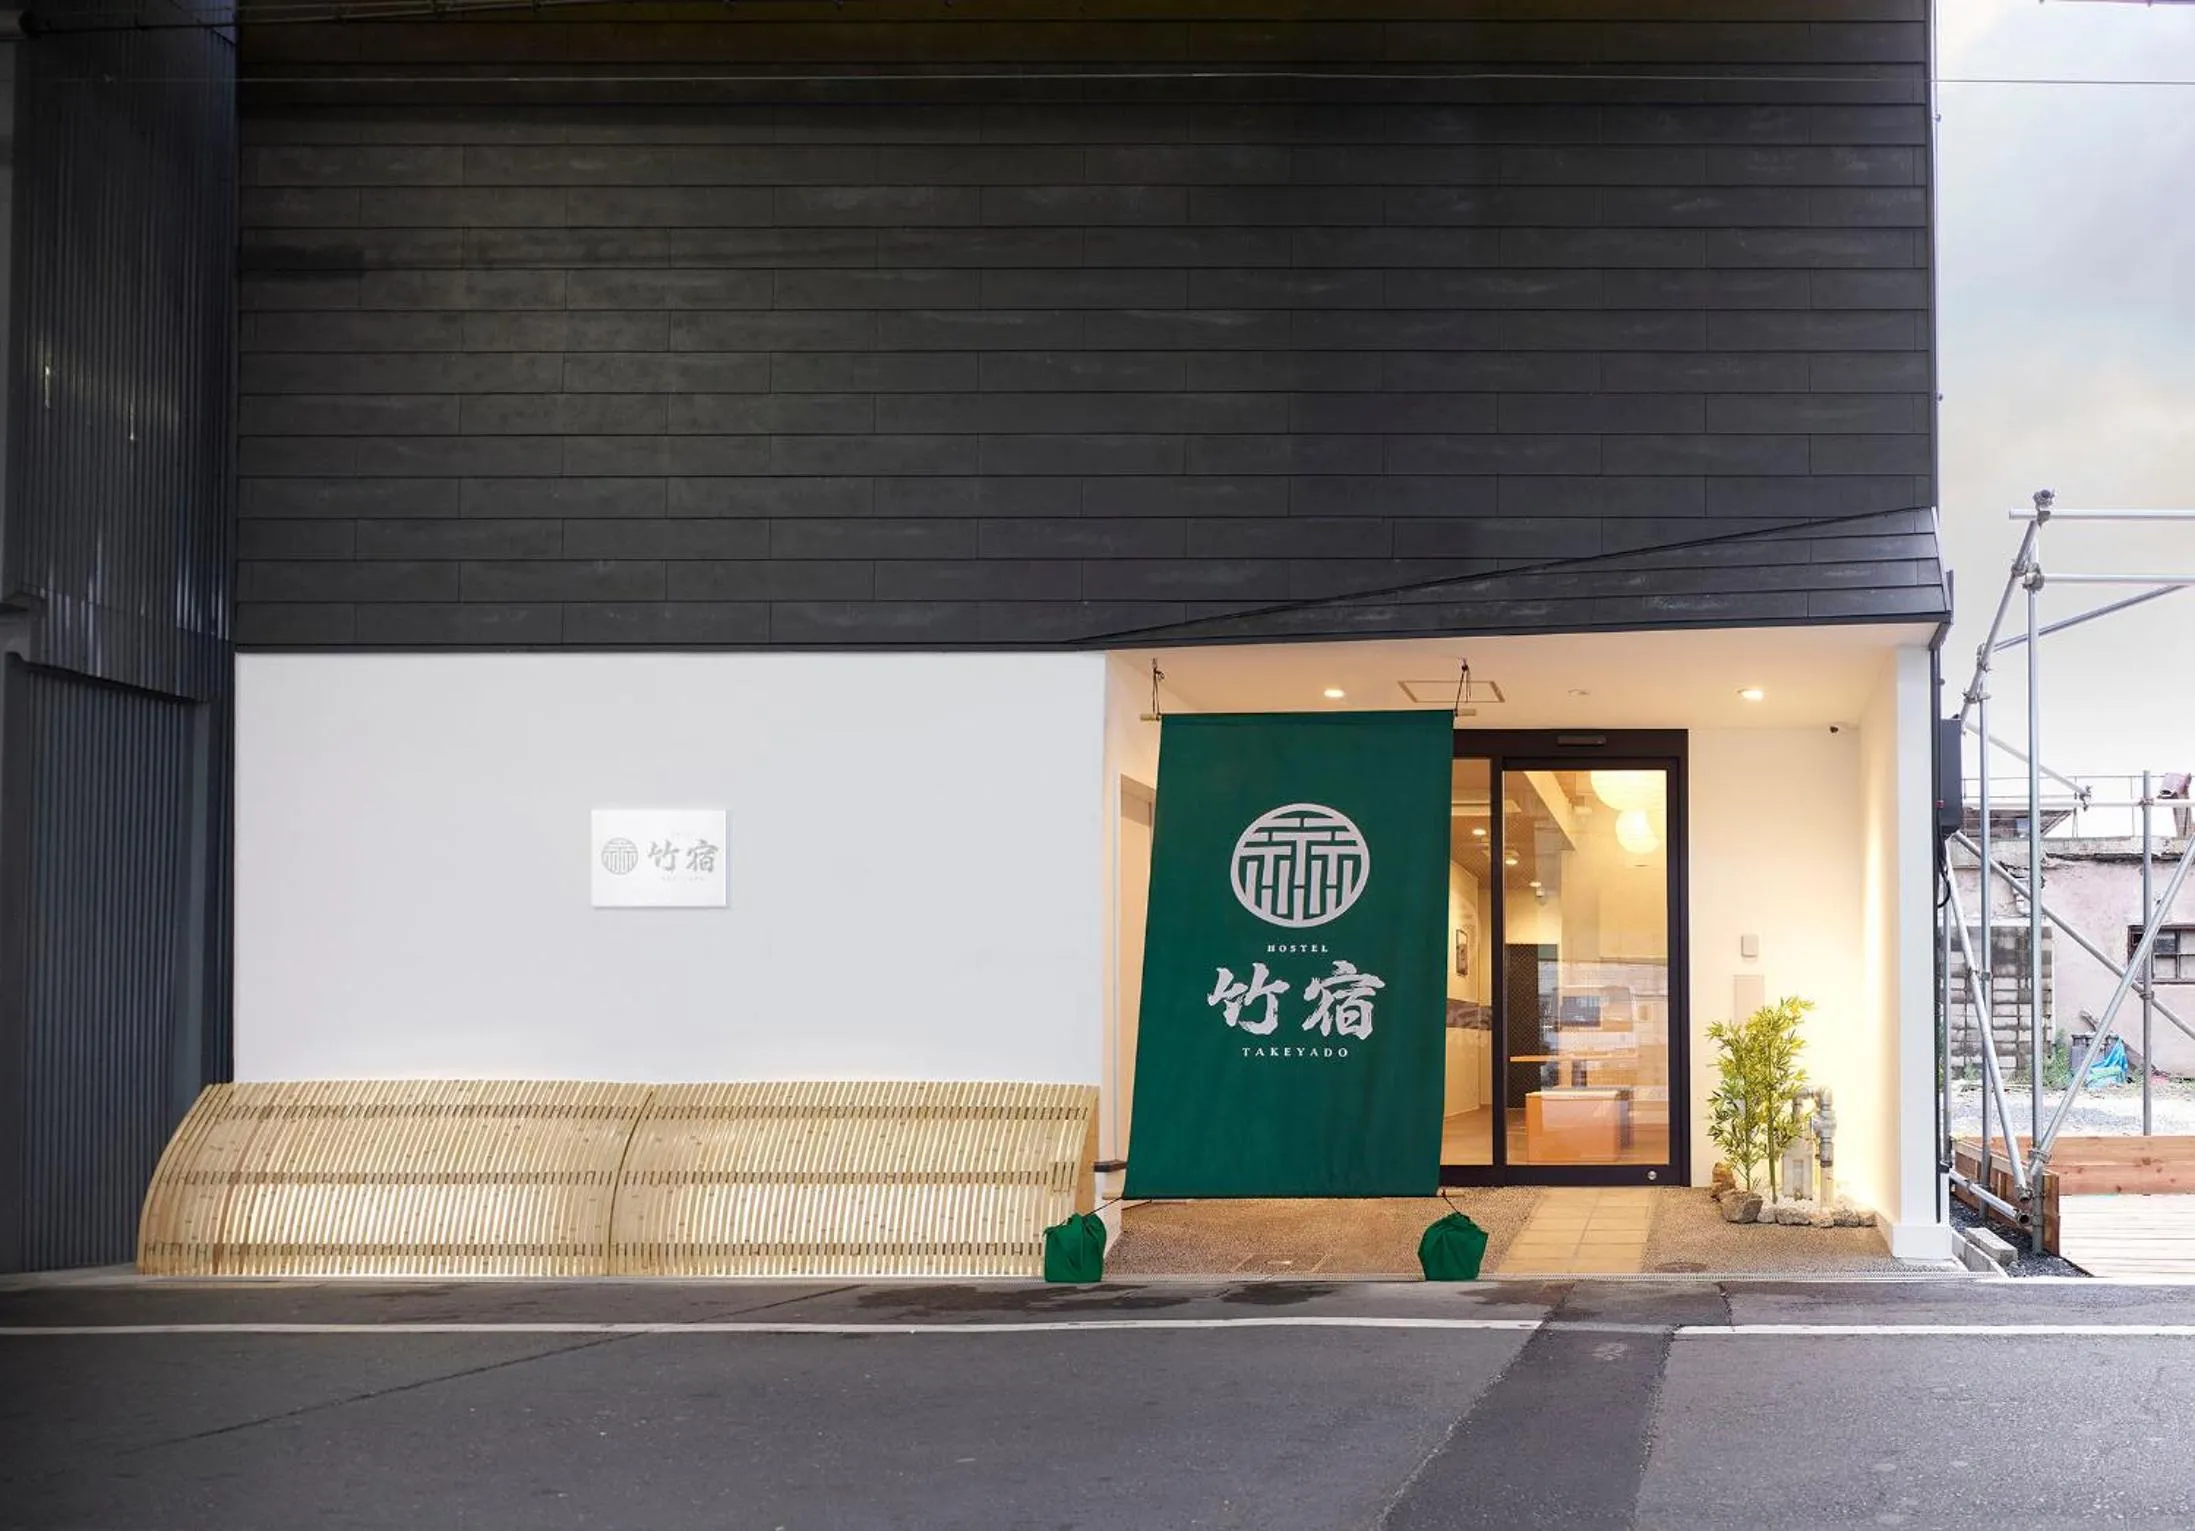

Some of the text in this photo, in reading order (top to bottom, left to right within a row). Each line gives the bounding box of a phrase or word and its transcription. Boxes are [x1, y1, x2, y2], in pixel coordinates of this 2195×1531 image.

[647, 839, 719, 873] 竹宿
[1266, 943, 1329, 954] HOSTEL
[1207, 959, 1386, 1041] 竹宿
[1241, 1046, 1349, 1058] TAKEYADO
